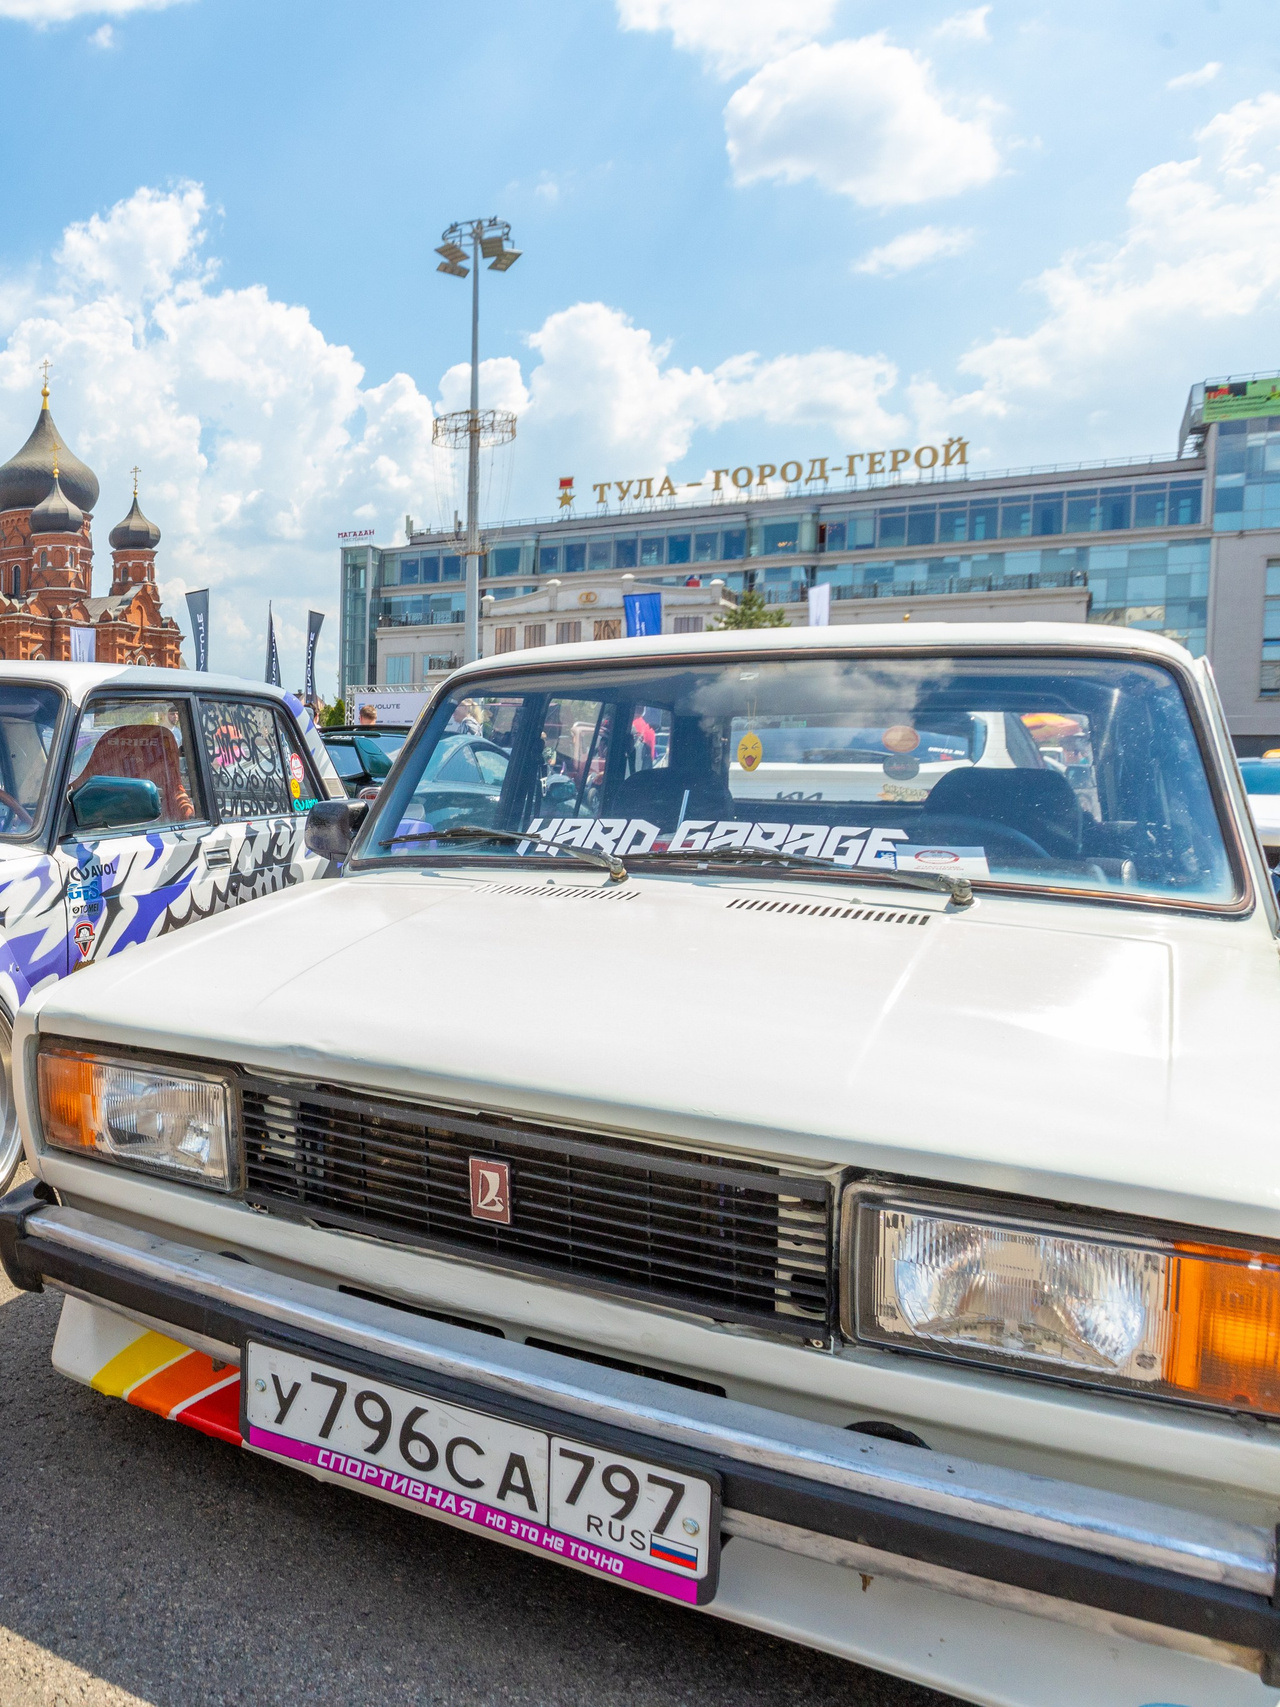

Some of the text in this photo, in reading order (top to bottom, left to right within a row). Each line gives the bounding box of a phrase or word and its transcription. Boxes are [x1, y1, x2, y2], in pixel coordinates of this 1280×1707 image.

[592, 475, 677, 503] ТУЛА
[712, 436, 970, 492] ГОРОД-ГЕРОЙ
[337, 529, 375, 539] МАГАДАН
[306, 631, 316, 695] EVOLUTE
[107, 737, 159, 747] BRIDE
[515, 818, 661, 857] HARD
[667, 820, 909, 870] GARAGE
[91, 863, 117, 878] AVOL
[316, 1449, 477, 1520] СПОРТИВНАЯ
[485, 1511, 507, 1530] НО
[510, 1520, 539, 1543] ЭТО
[569, 1542, 624, 1575] ТОЧНО
[558, 1446, 686, 1536] 797
[586, 1513, 646, 1552] RUS
